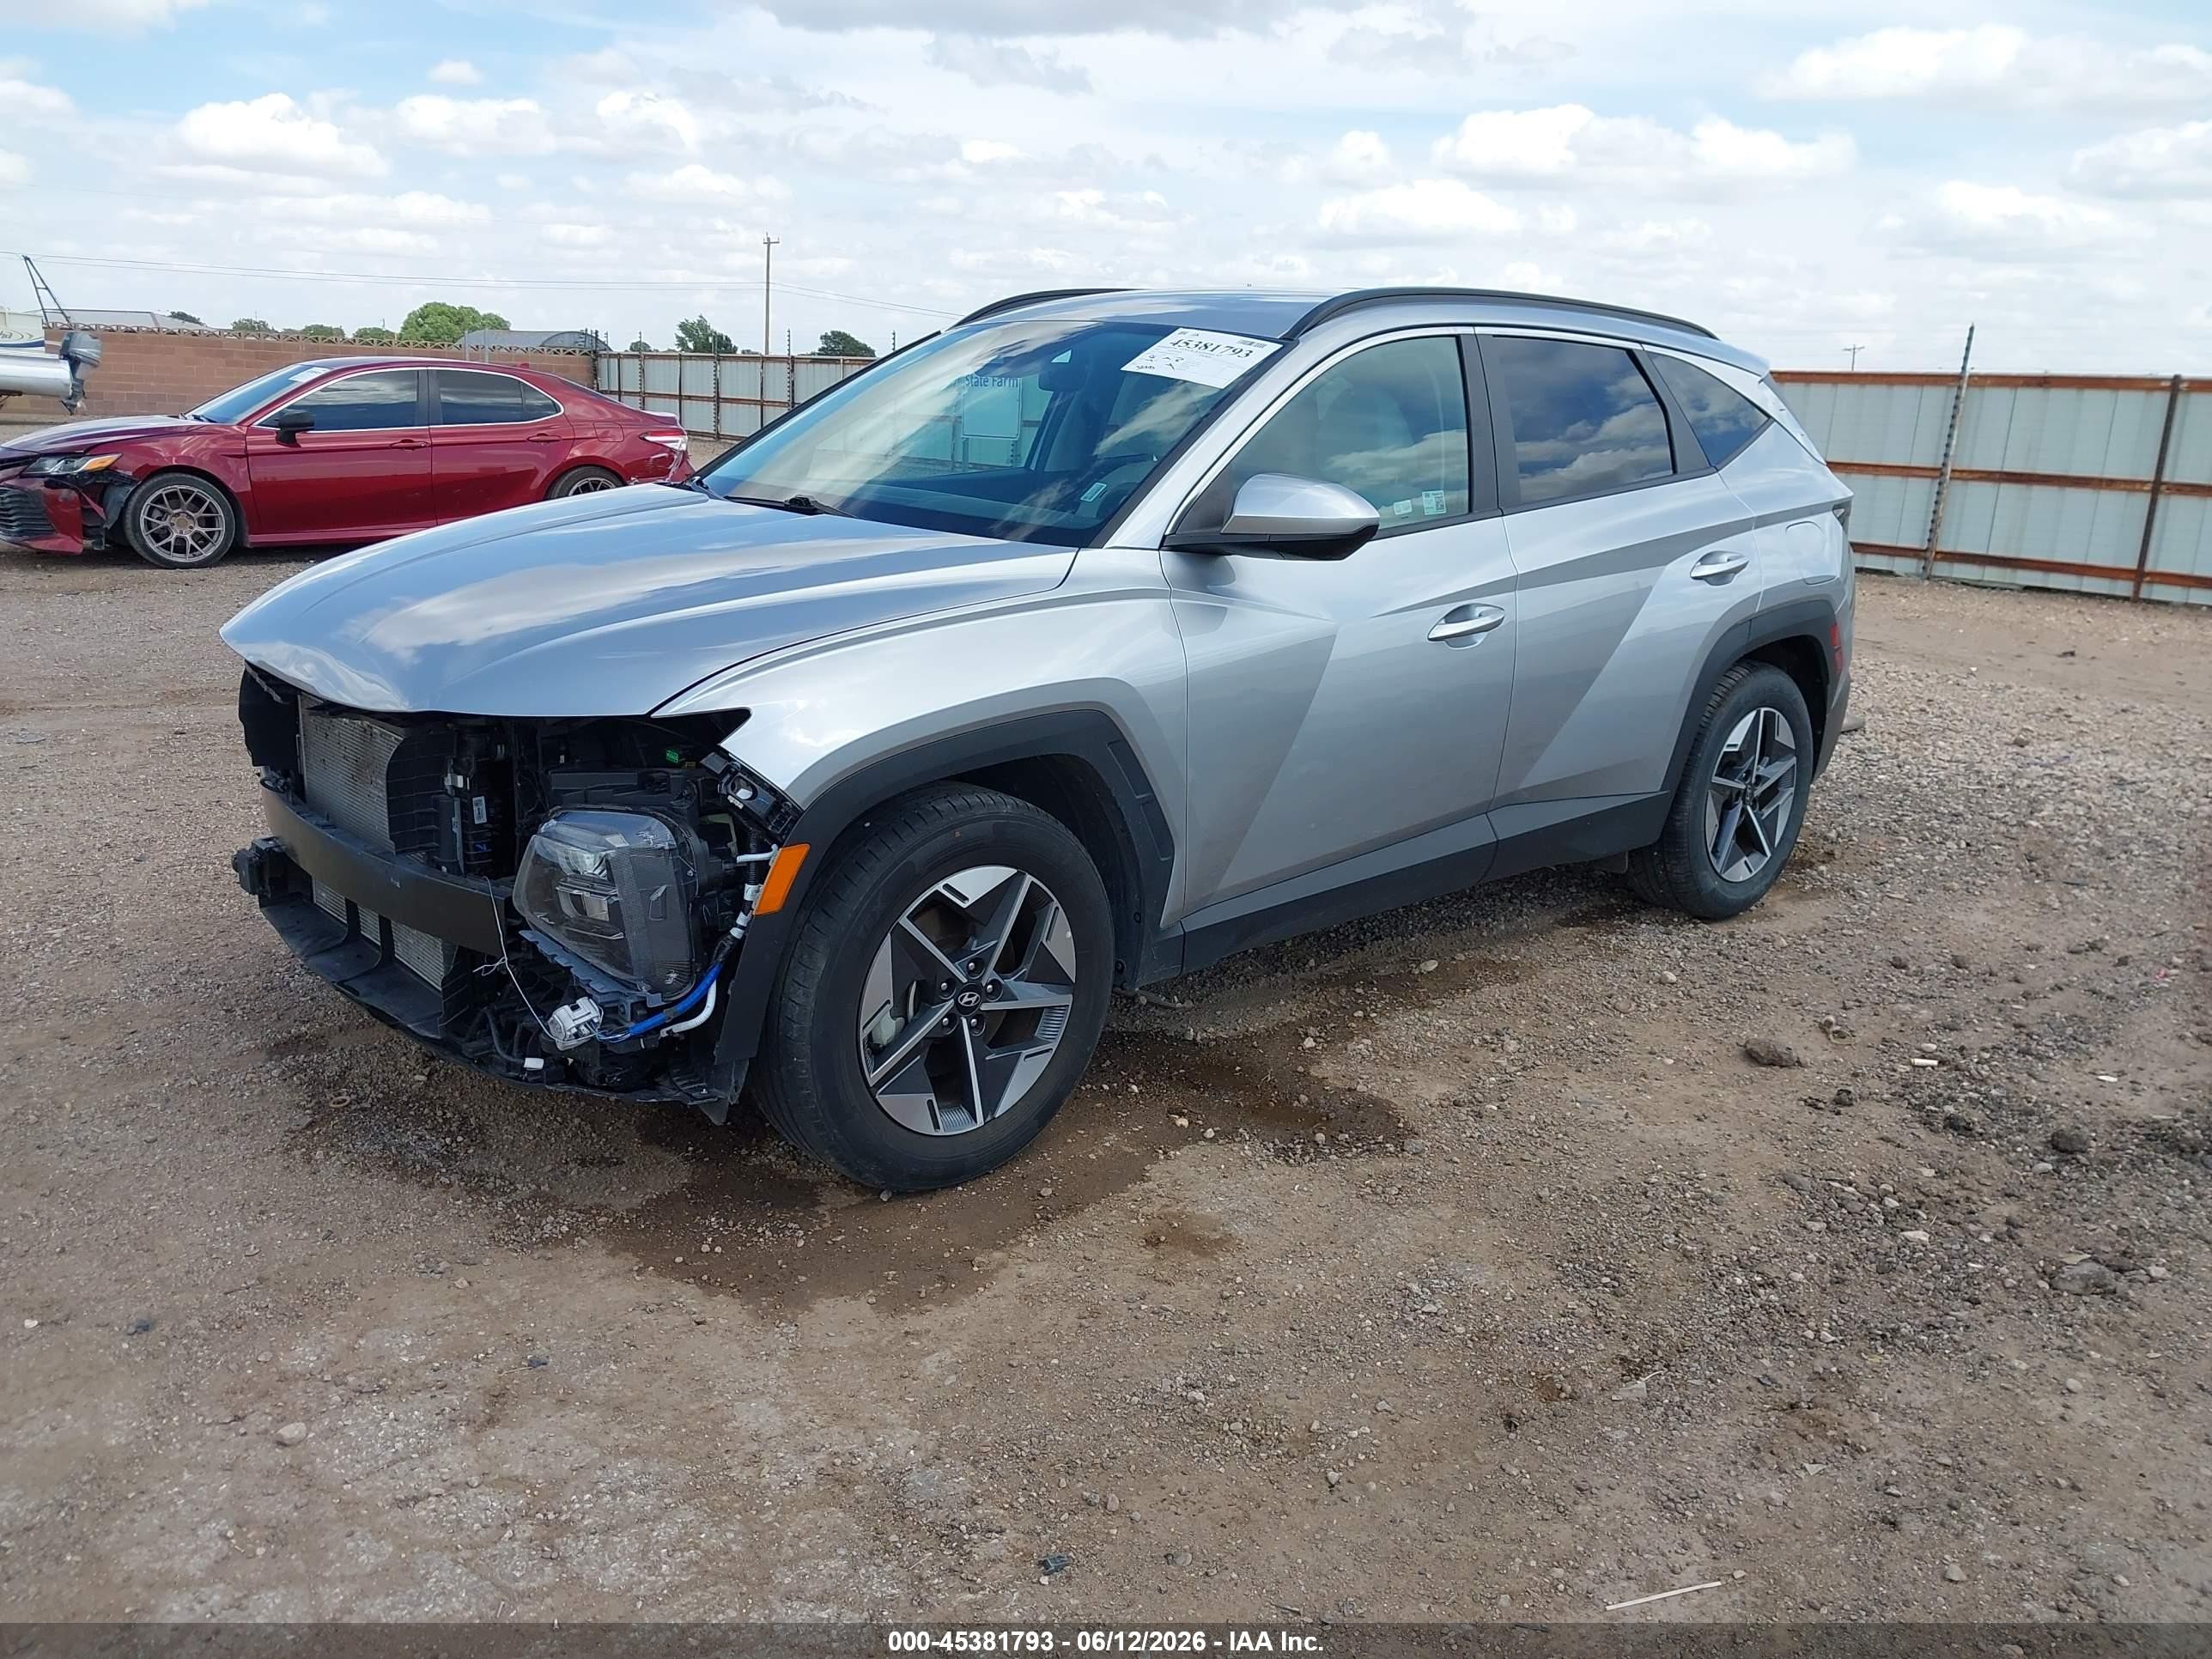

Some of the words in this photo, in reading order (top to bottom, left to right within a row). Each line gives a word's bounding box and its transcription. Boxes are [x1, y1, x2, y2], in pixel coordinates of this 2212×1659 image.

[1170, 338, 1254, 359] 45381793
[965, 375, 989, 387] State
[992, 377, 1018, 387] Farm
